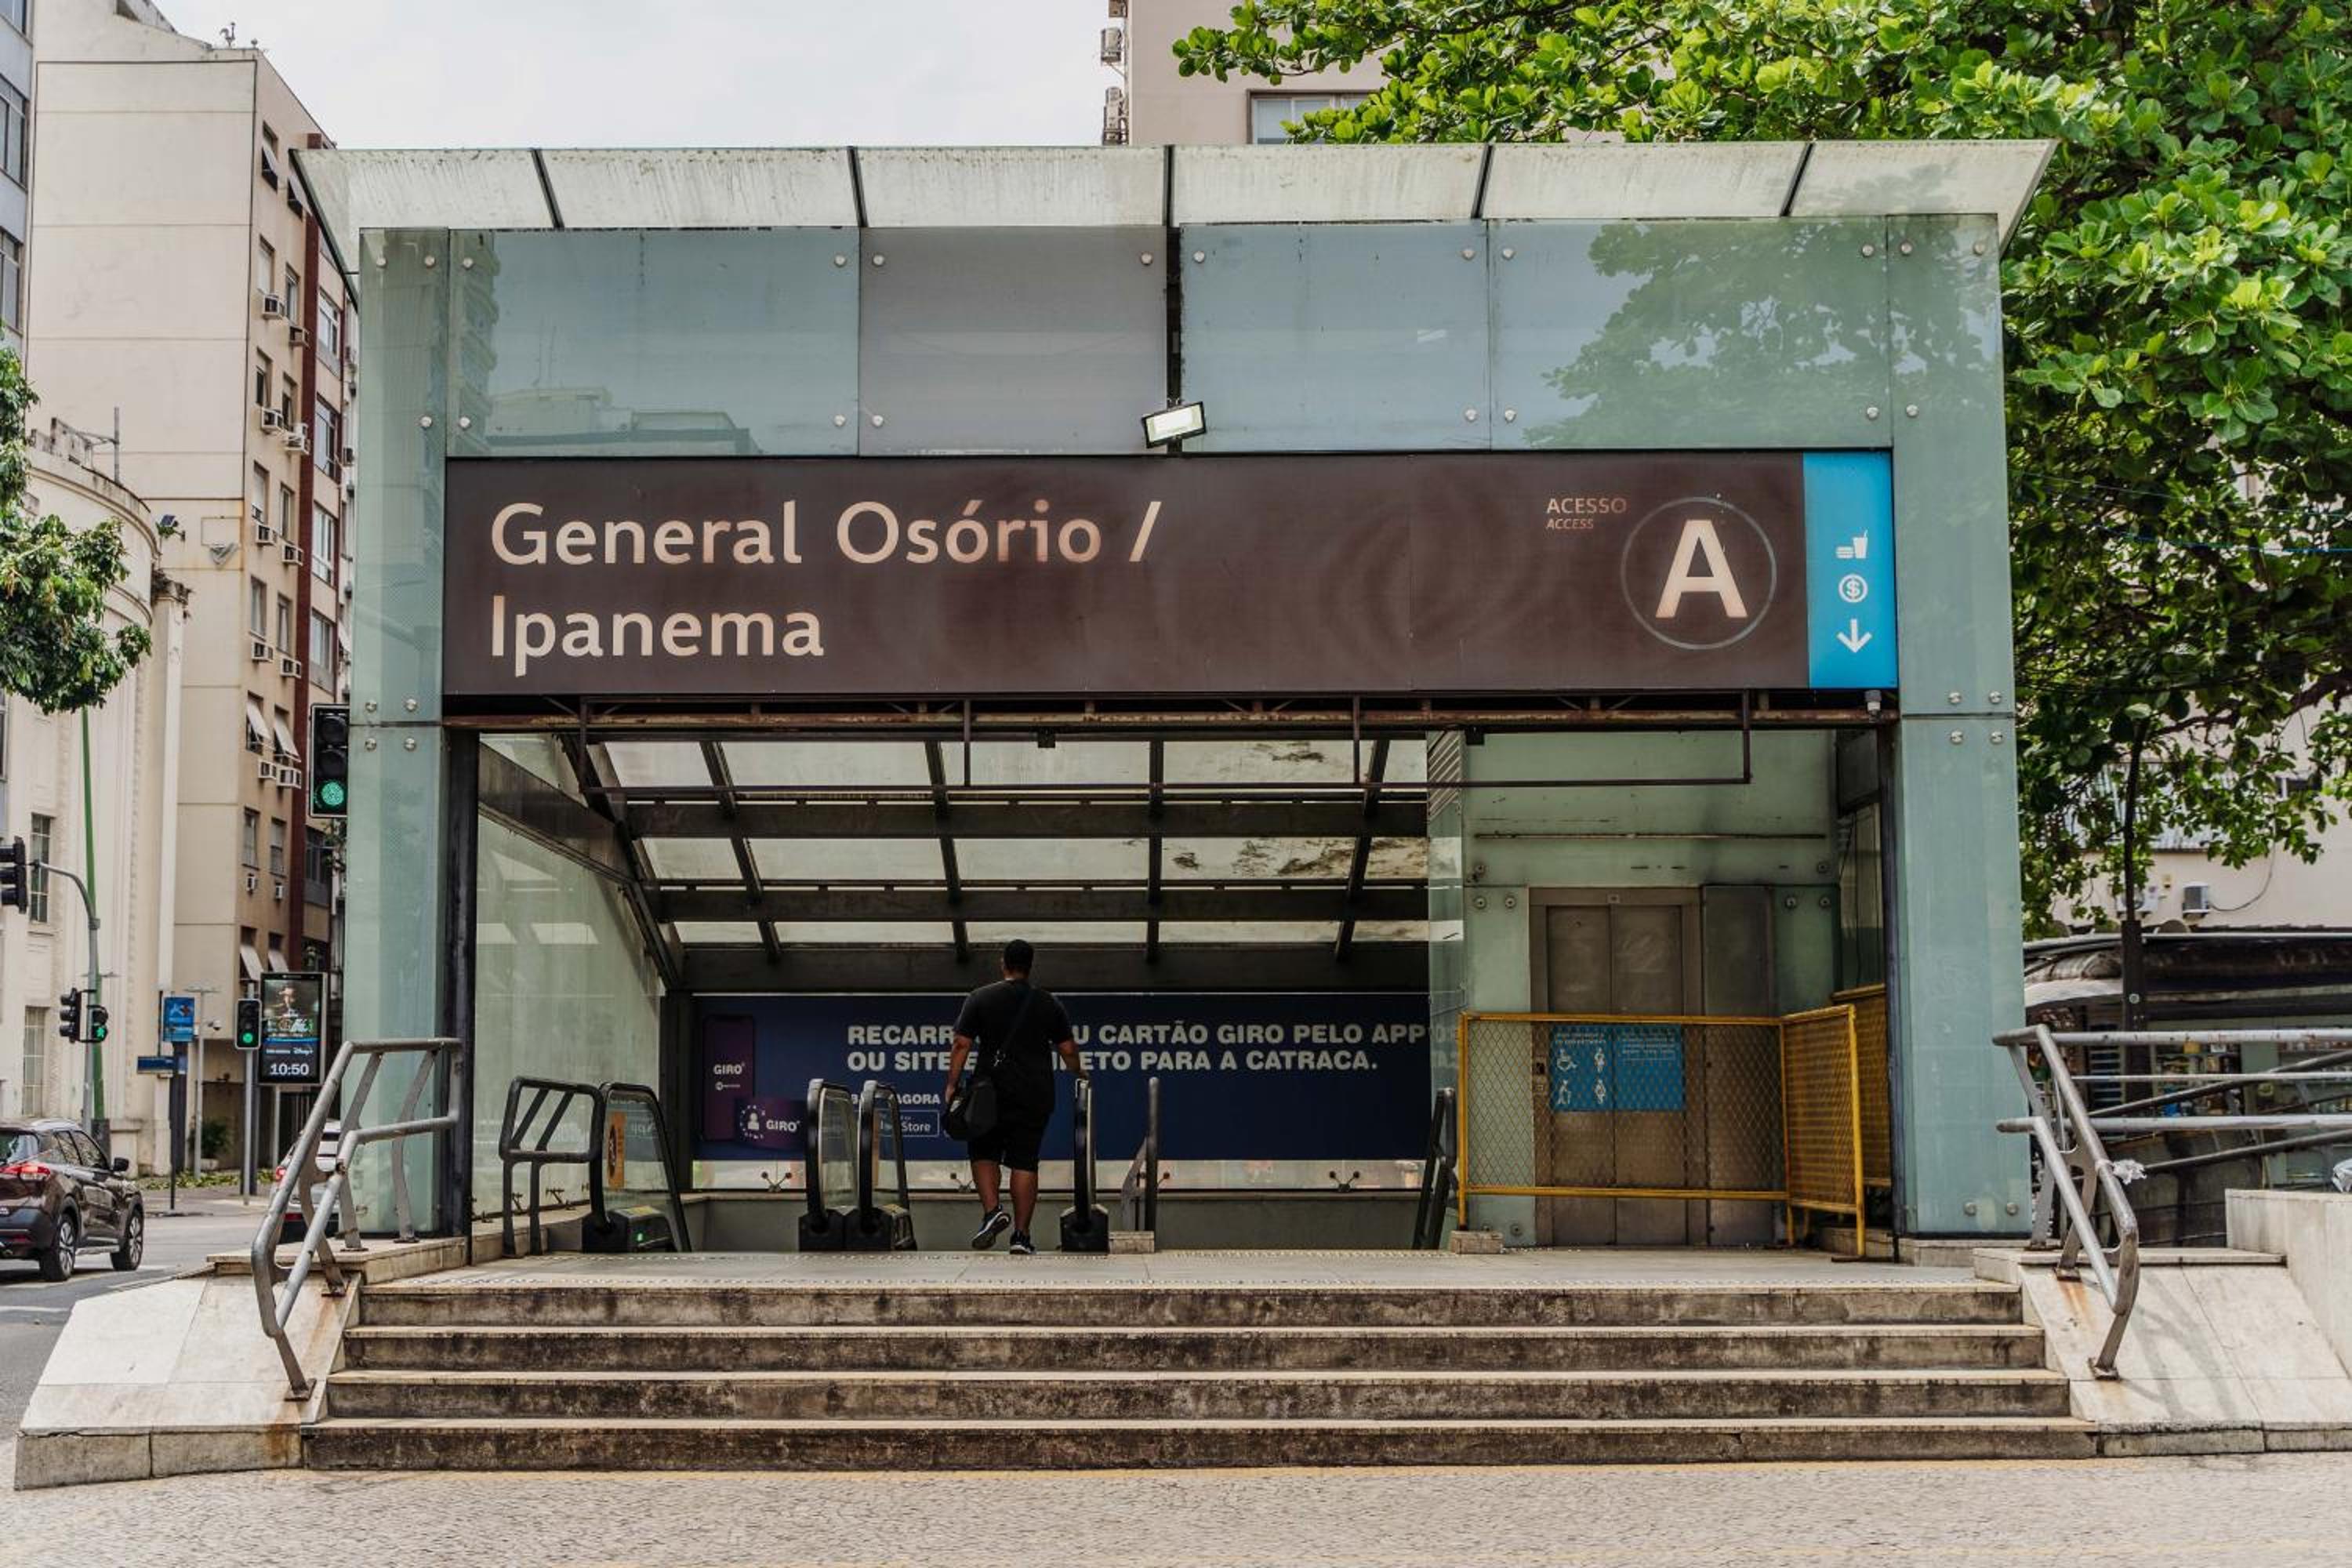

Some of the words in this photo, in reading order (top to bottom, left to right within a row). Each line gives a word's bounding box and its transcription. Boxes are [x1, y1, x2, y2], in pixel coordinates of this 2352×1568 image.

[1546, 498, 1627, 514] ACESSO
[492, 500, 802, 565] General
[837, 499, 1102, 564] Osório
[1129, 500, 1163, 562] /
[1546, 518, 1595, 530] ACCESS
[1655, 519, 1748, 619] A
[492, 595, 825, 677] Ipanema
[848, 1025, 980, 1045] RECARR
[1098, 1020, 1208, 1045] CARTÃO
[1217, 1024, 1284, 1044] GIRO
[1294, 1024, 1363, 1044] PELO
[1372, 1024, 1426, 1044] APP
[269, 1062, 310, 1076] 10:50
[848, 1051, 886, 1072] OU
[895, 1051, 952, 1072] SITE
[1140, 1051, 1211, 1071] PARA
[1219, 1051, 1238, 1071] A
[1245, 1050, 1378, 1071] CATRACA.
[713, 1064, 742, 1075] GIRO
[766, 1120, 797, 1132] GIRO
[901, 1122, 931, 1132] Store
